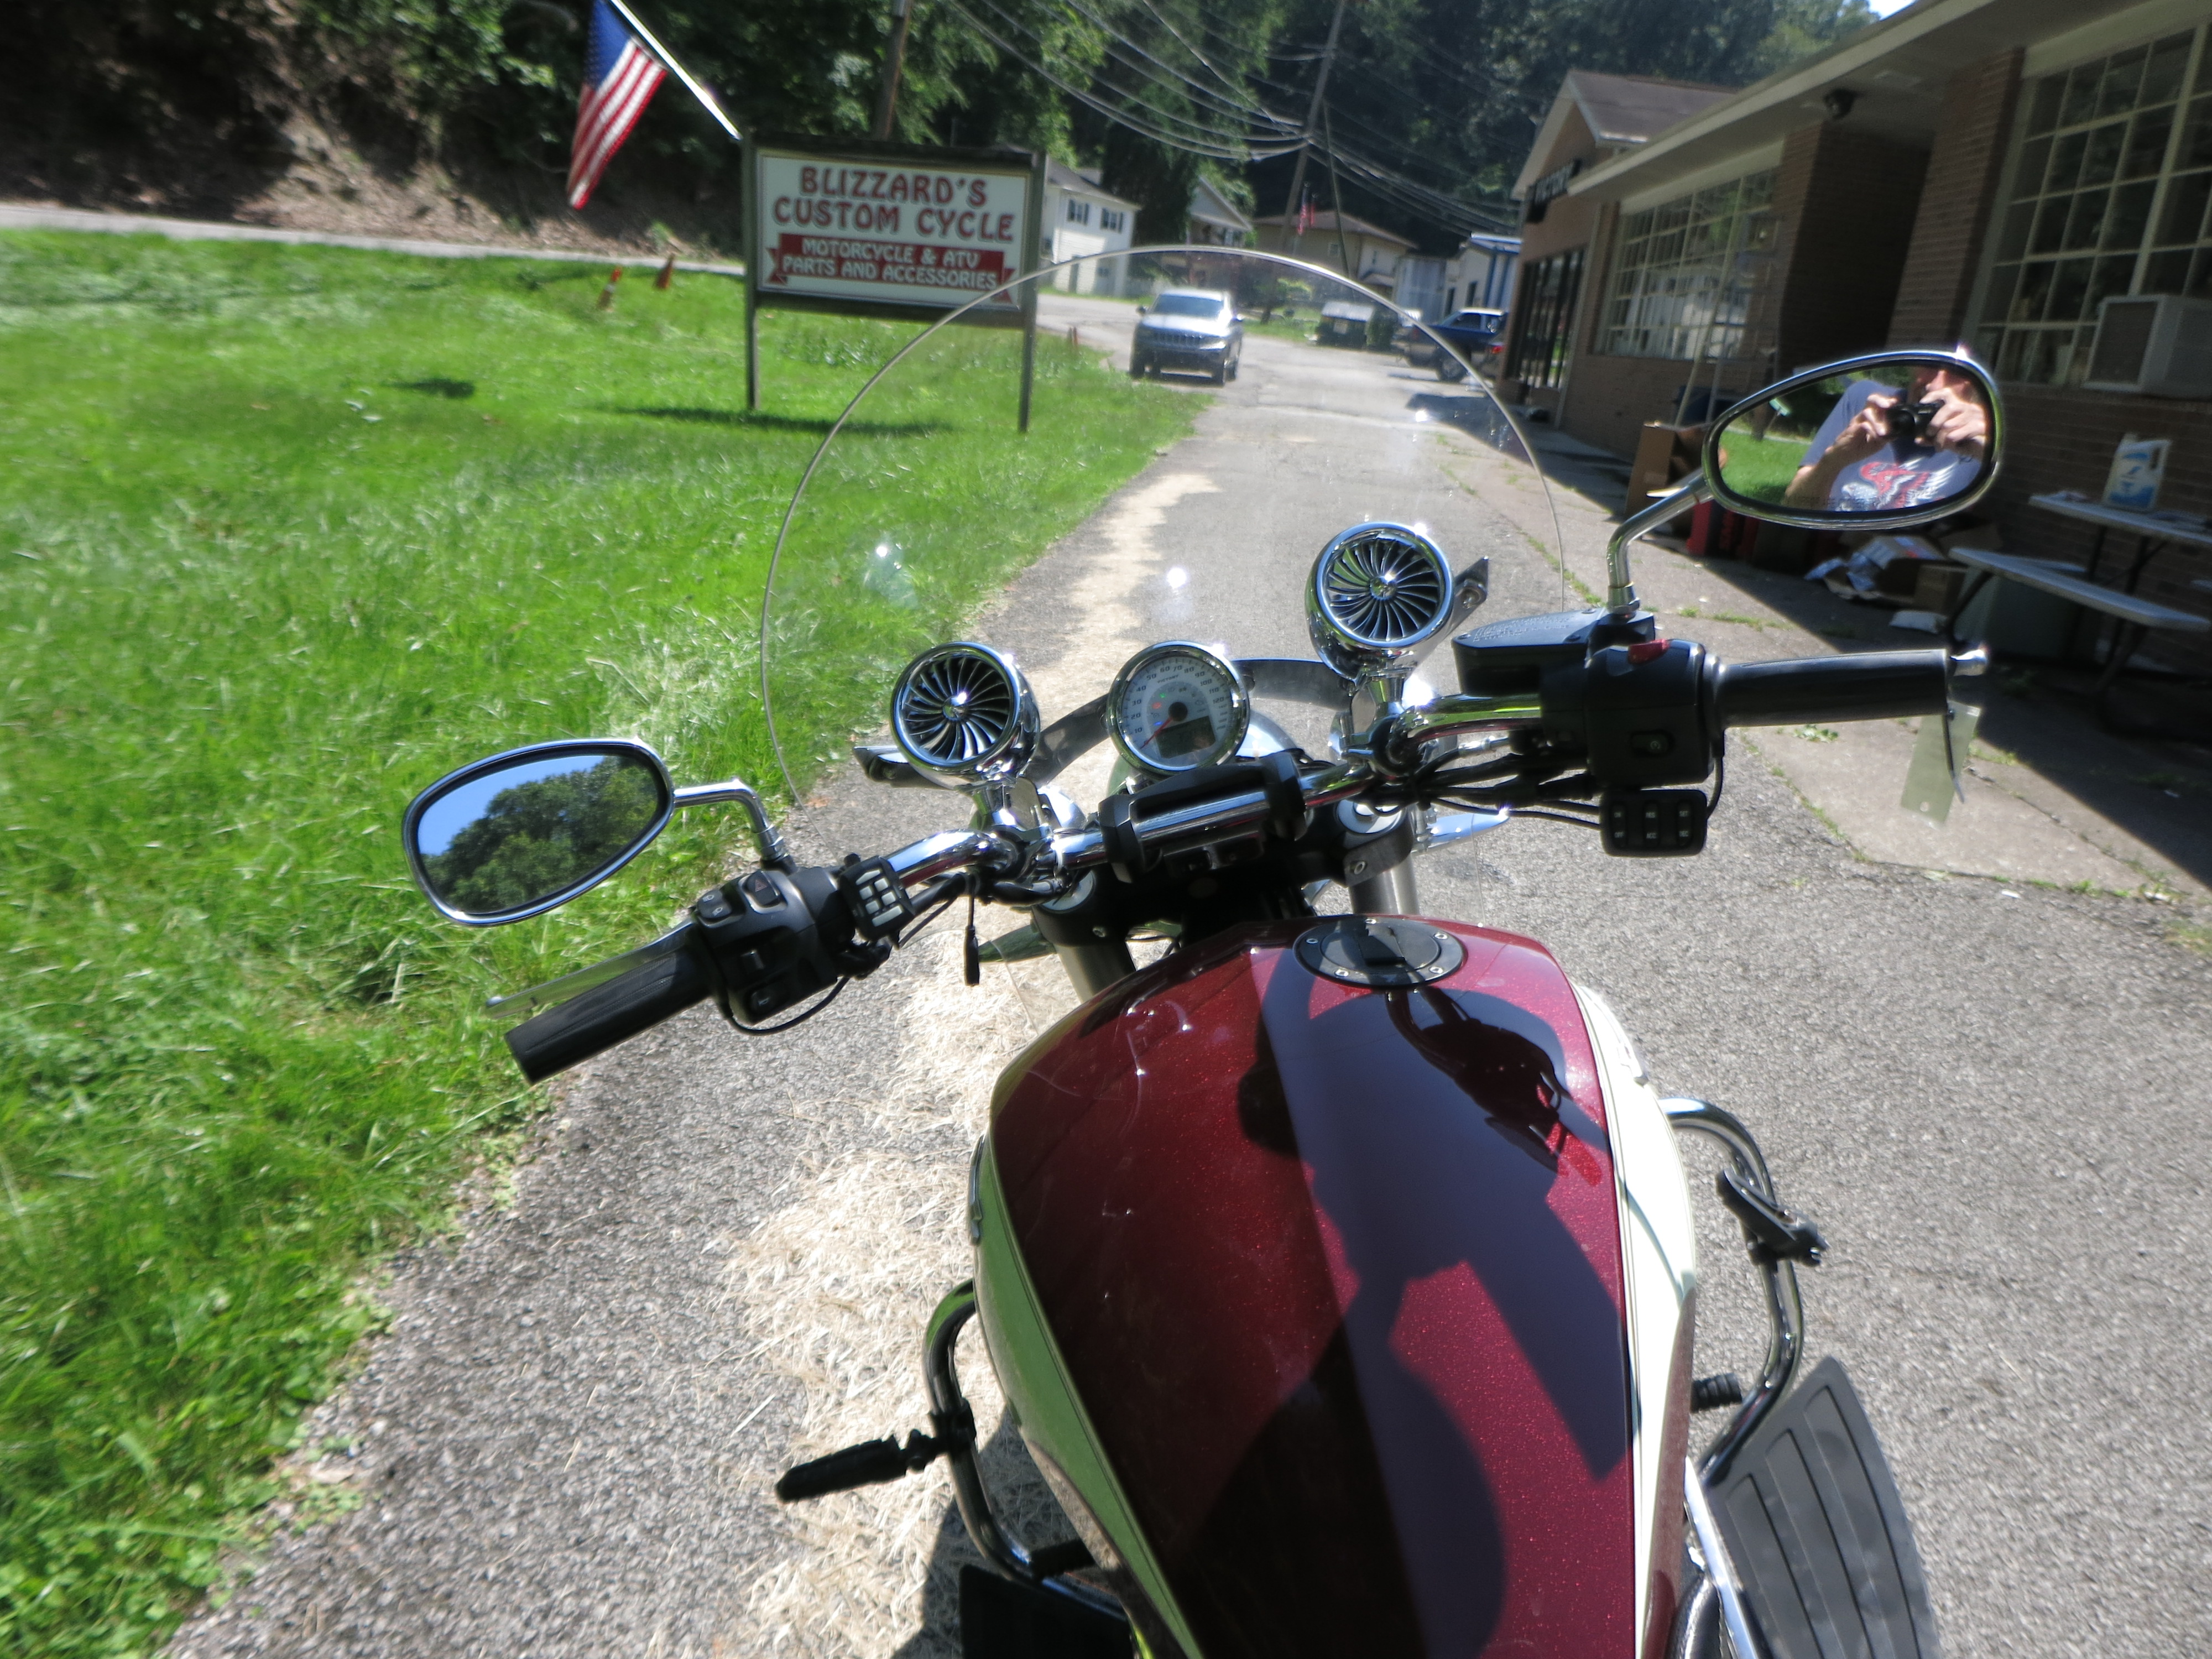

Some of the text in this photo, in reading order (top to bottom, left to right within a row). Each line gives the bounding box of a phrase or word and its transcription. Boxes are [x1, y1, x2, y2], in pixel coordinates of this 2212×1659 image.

[801, 166, 987, 207] BLIZZARD'S
[774, 197, 1015, 242] CUSTOM CYCLE
[802, 239, 980, 269] MOTORCYCLE & ATV
[782, 256, 996, 291] PARTS AND ACCESSORIES
[1157, 675, 1179, 683] VICTORY
